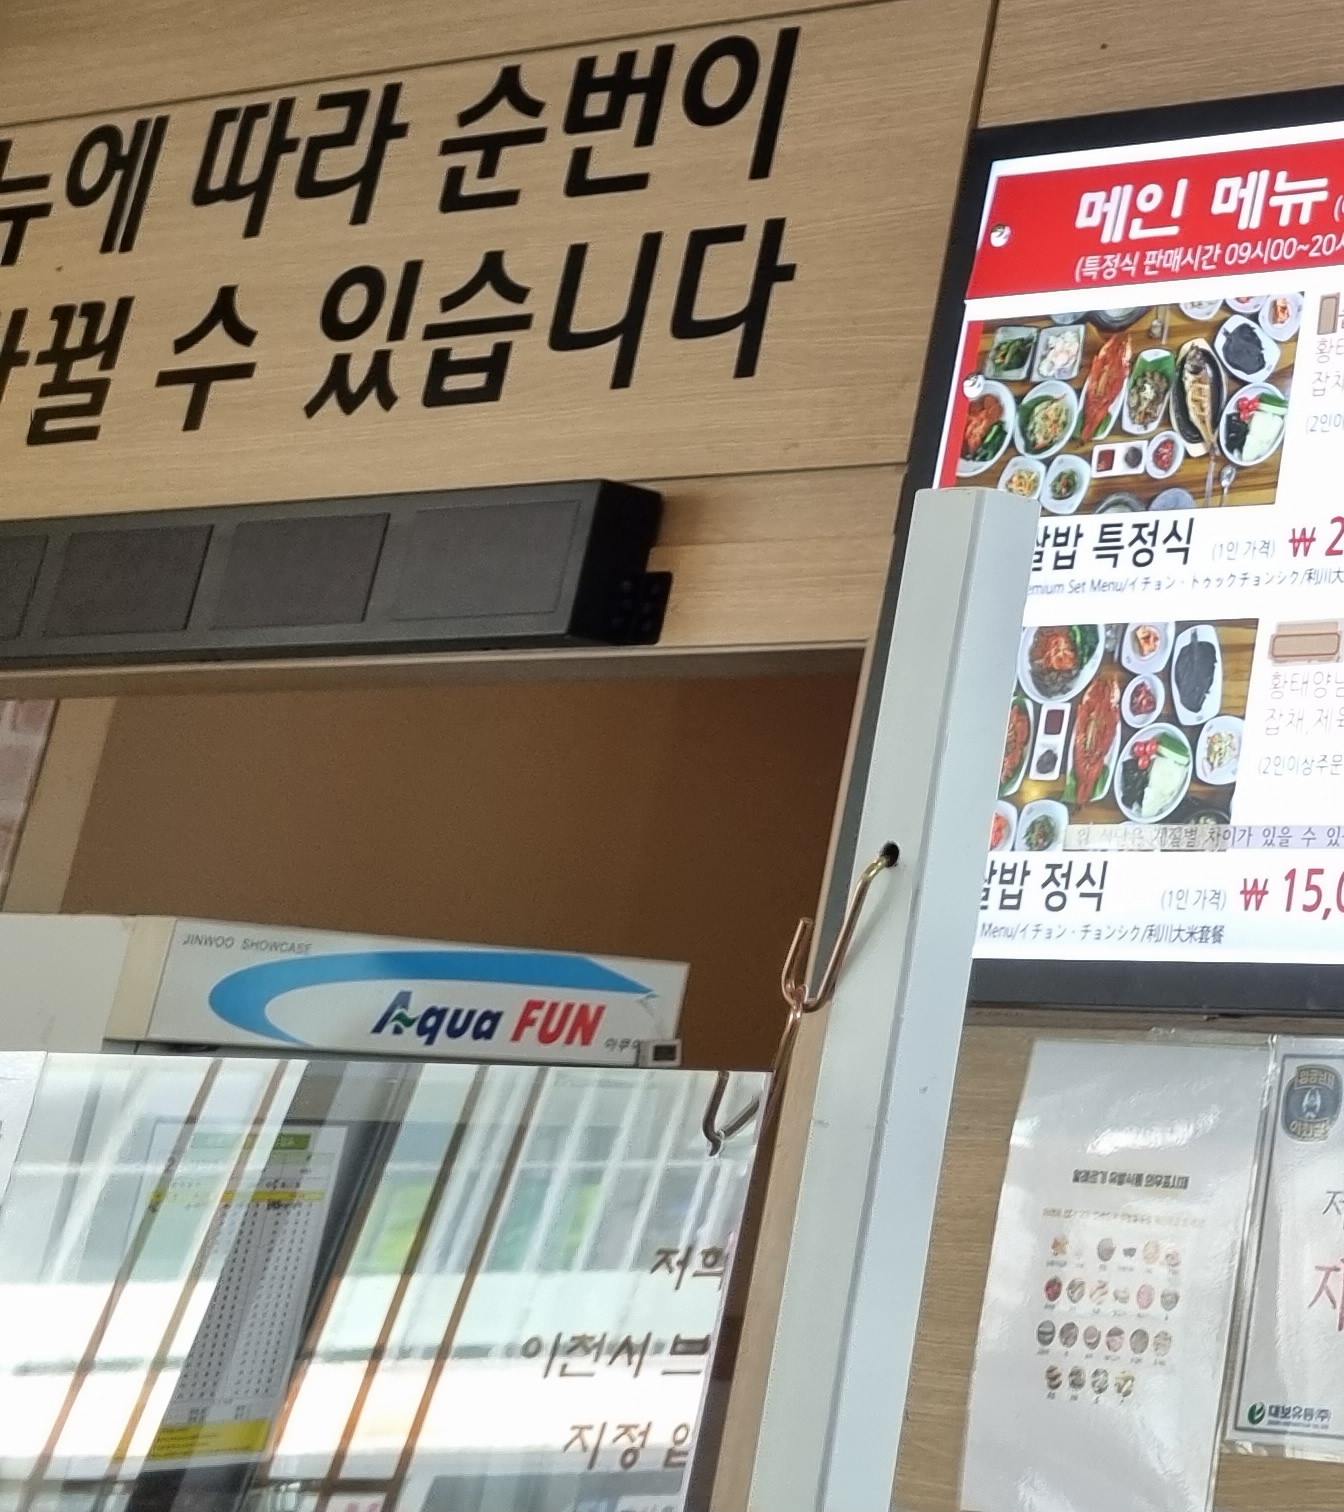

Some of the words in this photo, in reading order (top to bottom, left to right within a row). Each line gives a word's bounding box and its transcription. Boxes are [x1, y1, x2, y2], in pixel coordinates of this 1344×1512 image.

[191, 82, 409, 239] 따라
[438, 27, 800, 213] 순번이
[1075, 177, 1188, 244] 메인
[1210, 168, 1329, 233] 메뉴
[1075, 250, 1138, 283] (특정식
[1143, 246, 1222, 277] 판매시간
[156, 284, 258, 432] 수
[304, 217, 797, 420] 있습니다
[1093, 517, 1195, 569] 특정식
[1262, 825, 1291, 847] 있을
[1301, 826, 1317, 847] 수
[1042, 860, 1108, 912] 정식
[182, 934, 235, 950] JINWOO
[242, 937, 312, 955] SHOWCASE
[372, 991, 504, 1046] Aqua
[510, 999, 606, 1046] FUN
